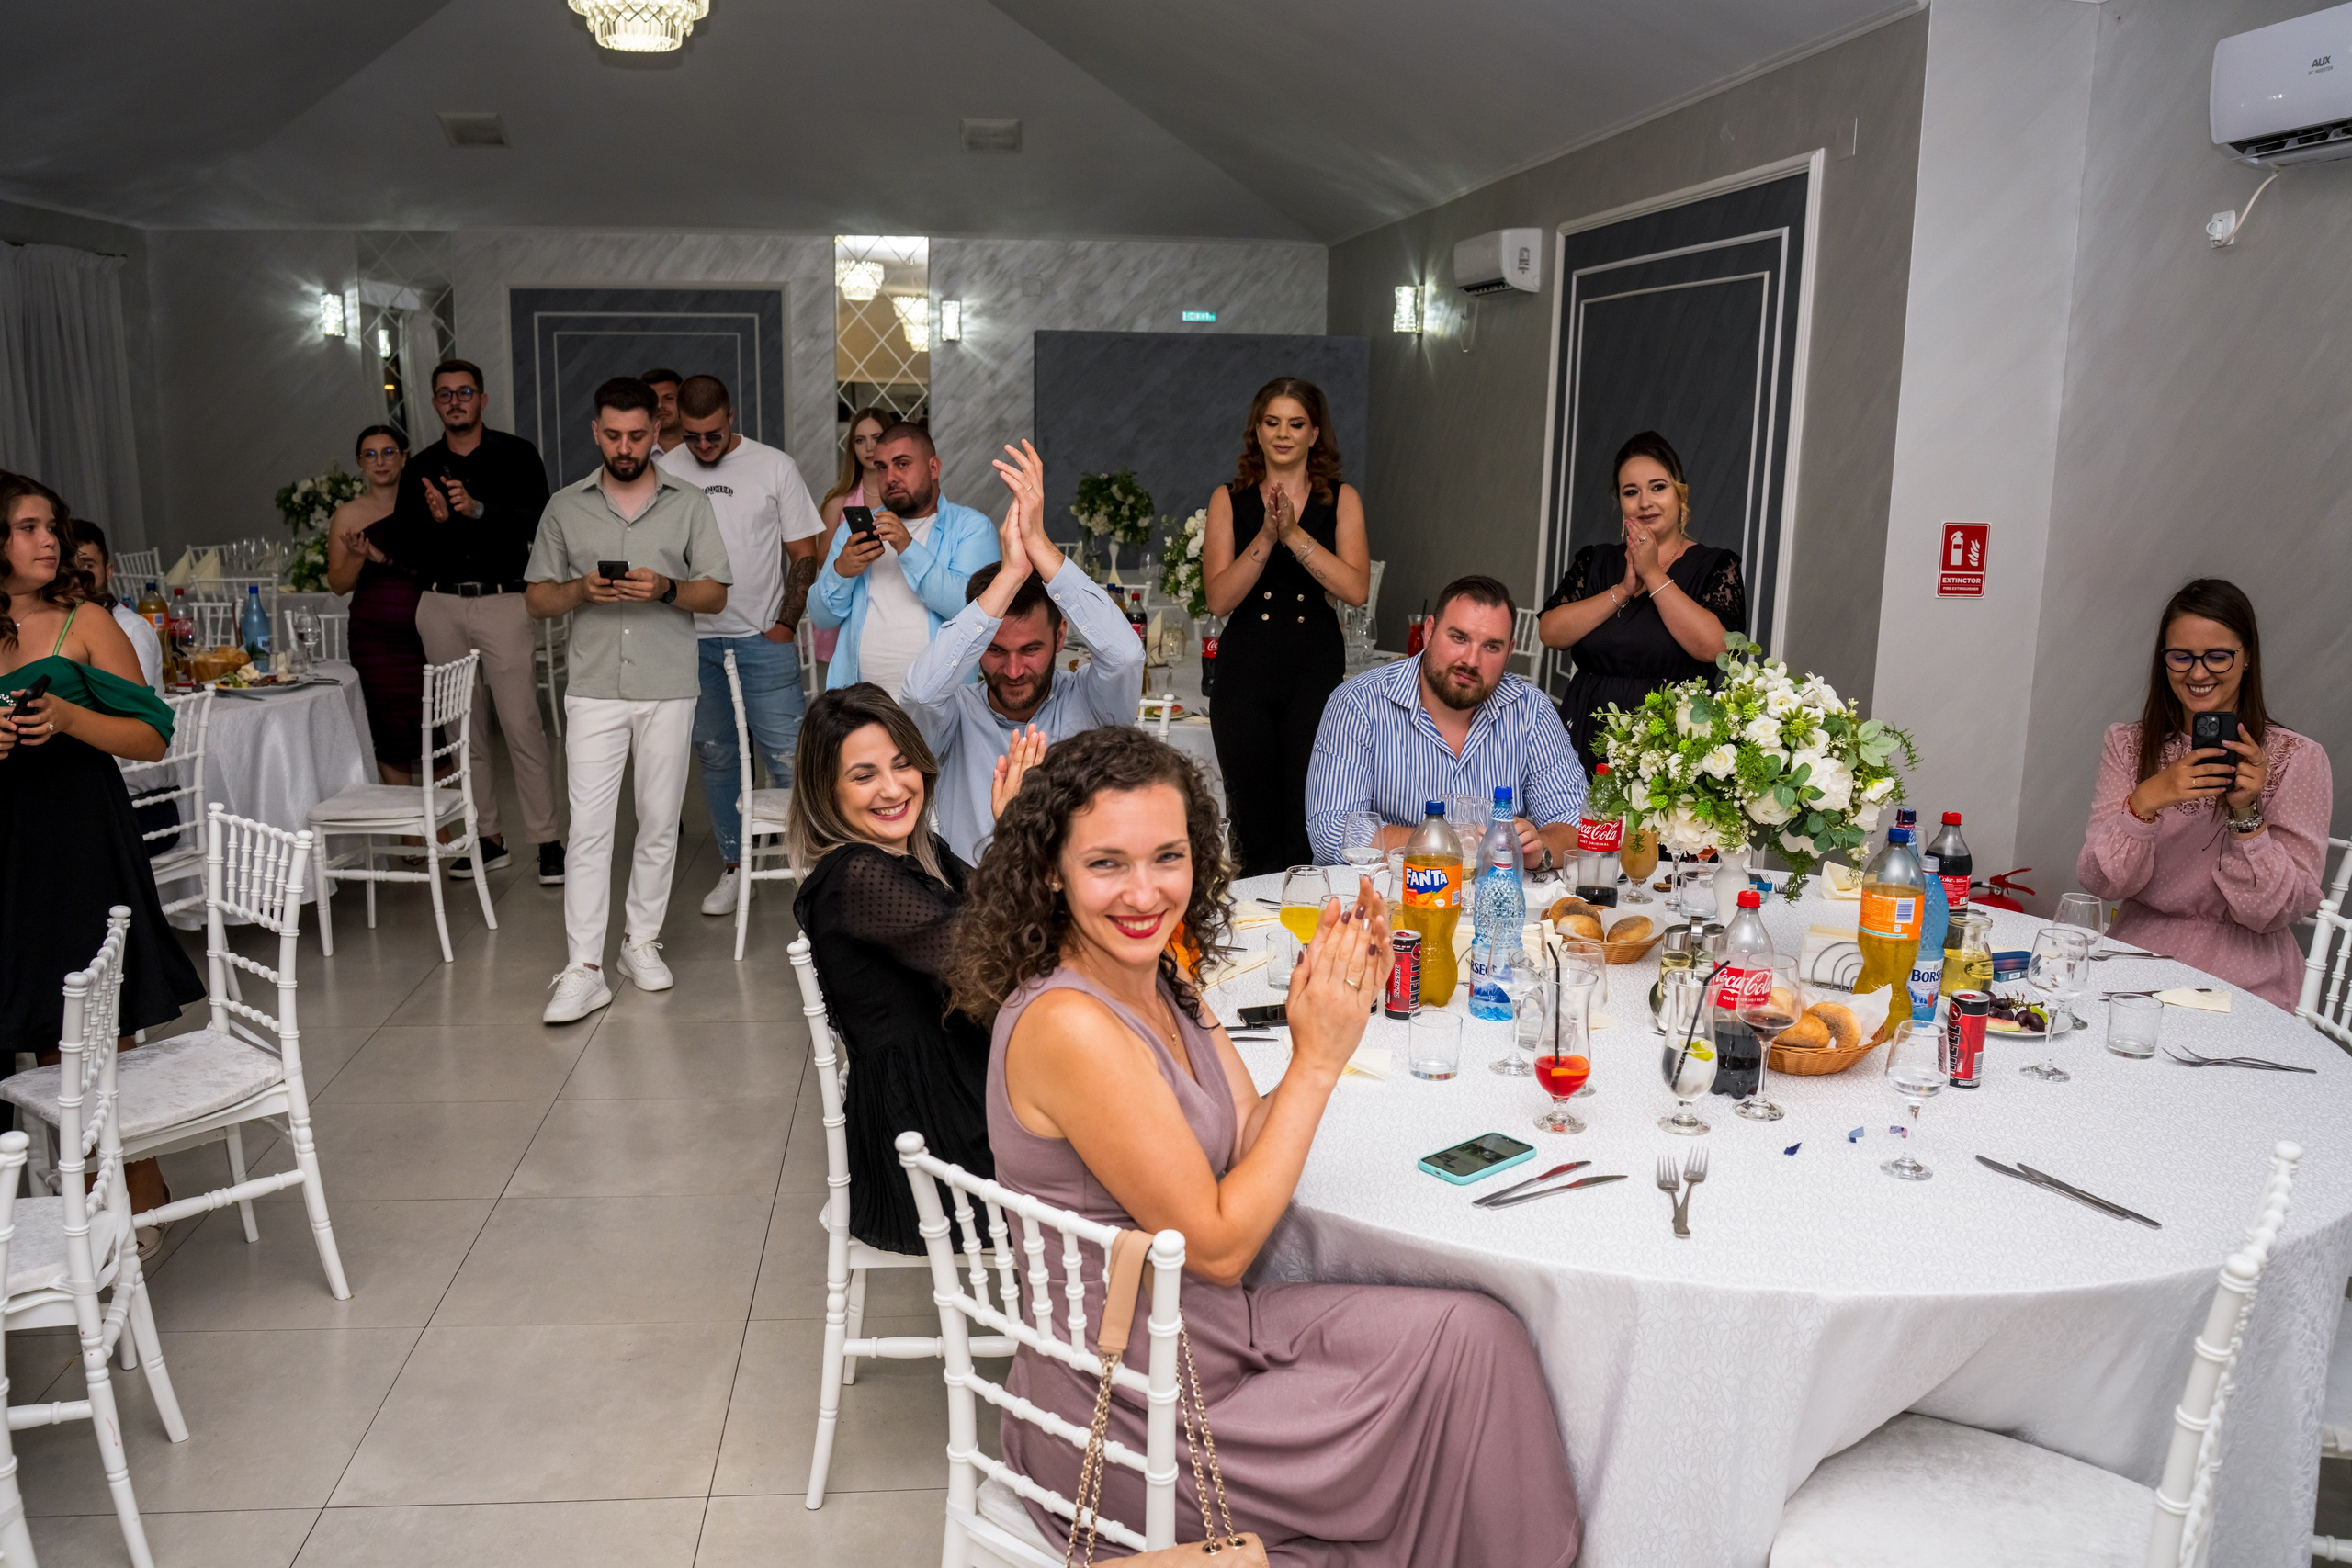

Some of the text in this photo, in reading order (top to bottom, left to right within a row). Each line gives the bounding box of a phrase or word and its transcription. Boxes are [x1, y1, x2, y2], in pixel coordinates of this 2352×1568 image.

[2311, 55, 2332, 68] AUX
[702, 484, 734, 497] OYALTY
[1406, 867, 1448, 886] FANTA
[1394, 963, 1402, 999] CLASSIC
